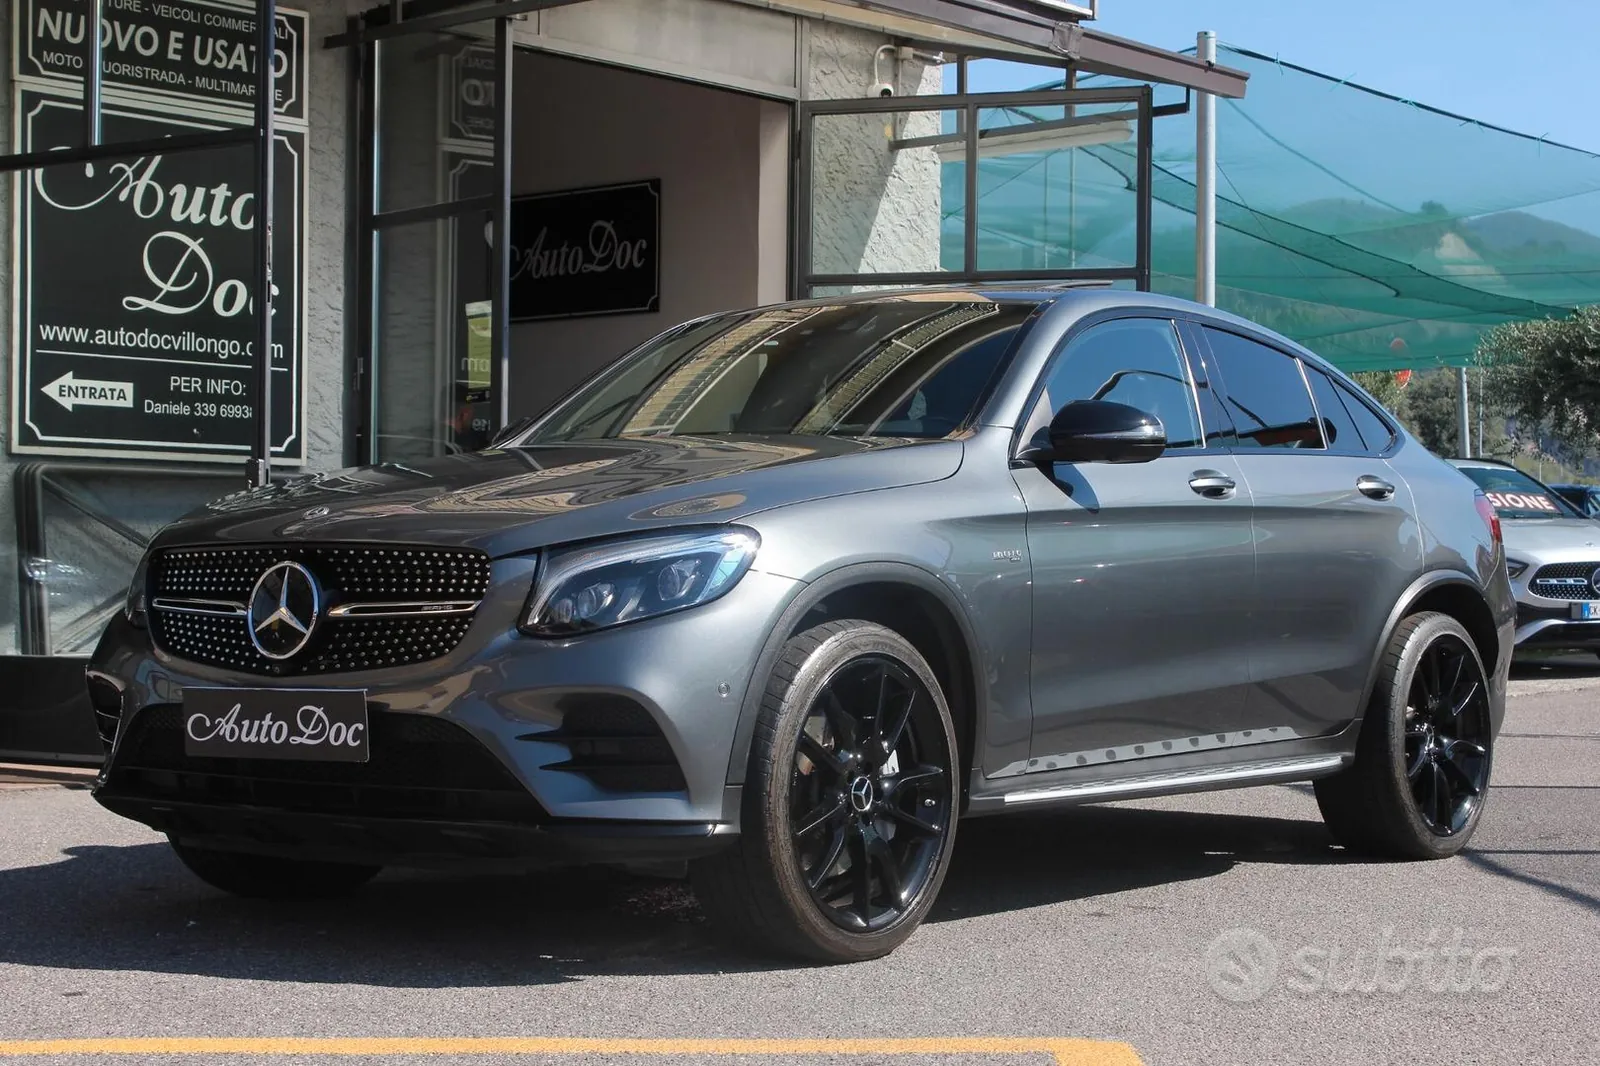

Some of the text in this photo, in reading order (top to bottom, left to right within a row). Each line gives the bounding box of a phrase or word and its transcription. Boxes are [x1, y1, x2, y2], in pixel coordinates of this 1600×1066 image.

[152, 4, 200, 23] VEICOLI
[167, 30, 184, 61] E
[43, 51, 83, 69] MOTO
[102, 60, 185, 85] UORISTRADA
[195, 76, 282, 101] MULTIMARE
[40, 324, 284, 358] www.autodocvillongo.cm
[58, 385, 127, 402] ENTRATA
[170, 376, 247, 396] PER INFO:
[144, 400, 190, 416] Daniele
[194, 403, 216, 417] 339
[1485, 492, 1556, 511] SIONE
